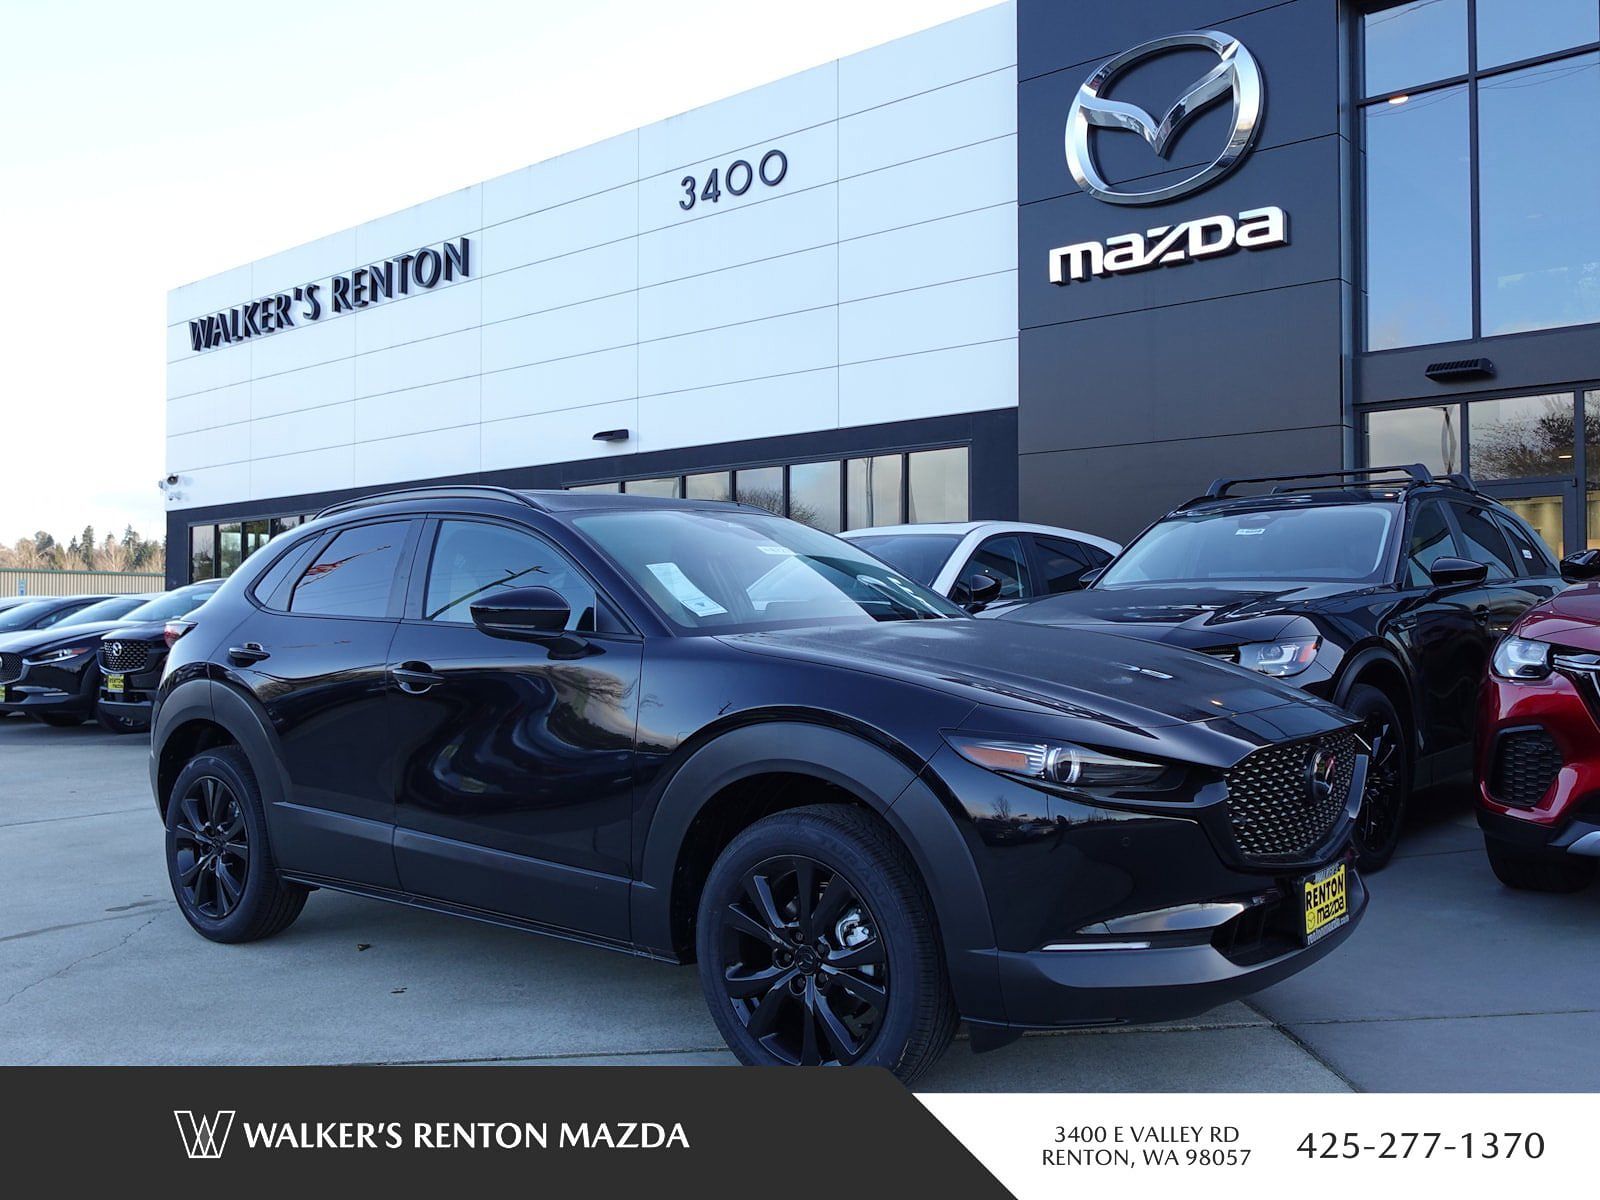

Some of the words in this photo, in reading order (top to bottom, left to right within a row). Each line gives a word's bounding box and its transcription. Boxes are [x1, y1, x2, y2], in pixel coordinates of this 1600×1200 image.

[679, 149, 788, 210] 3400
[189, 284, 321, 352] WALKER'S
[331, 237, 470, 314] RENTON
[1306, 874, 1344, 911] RENTON
